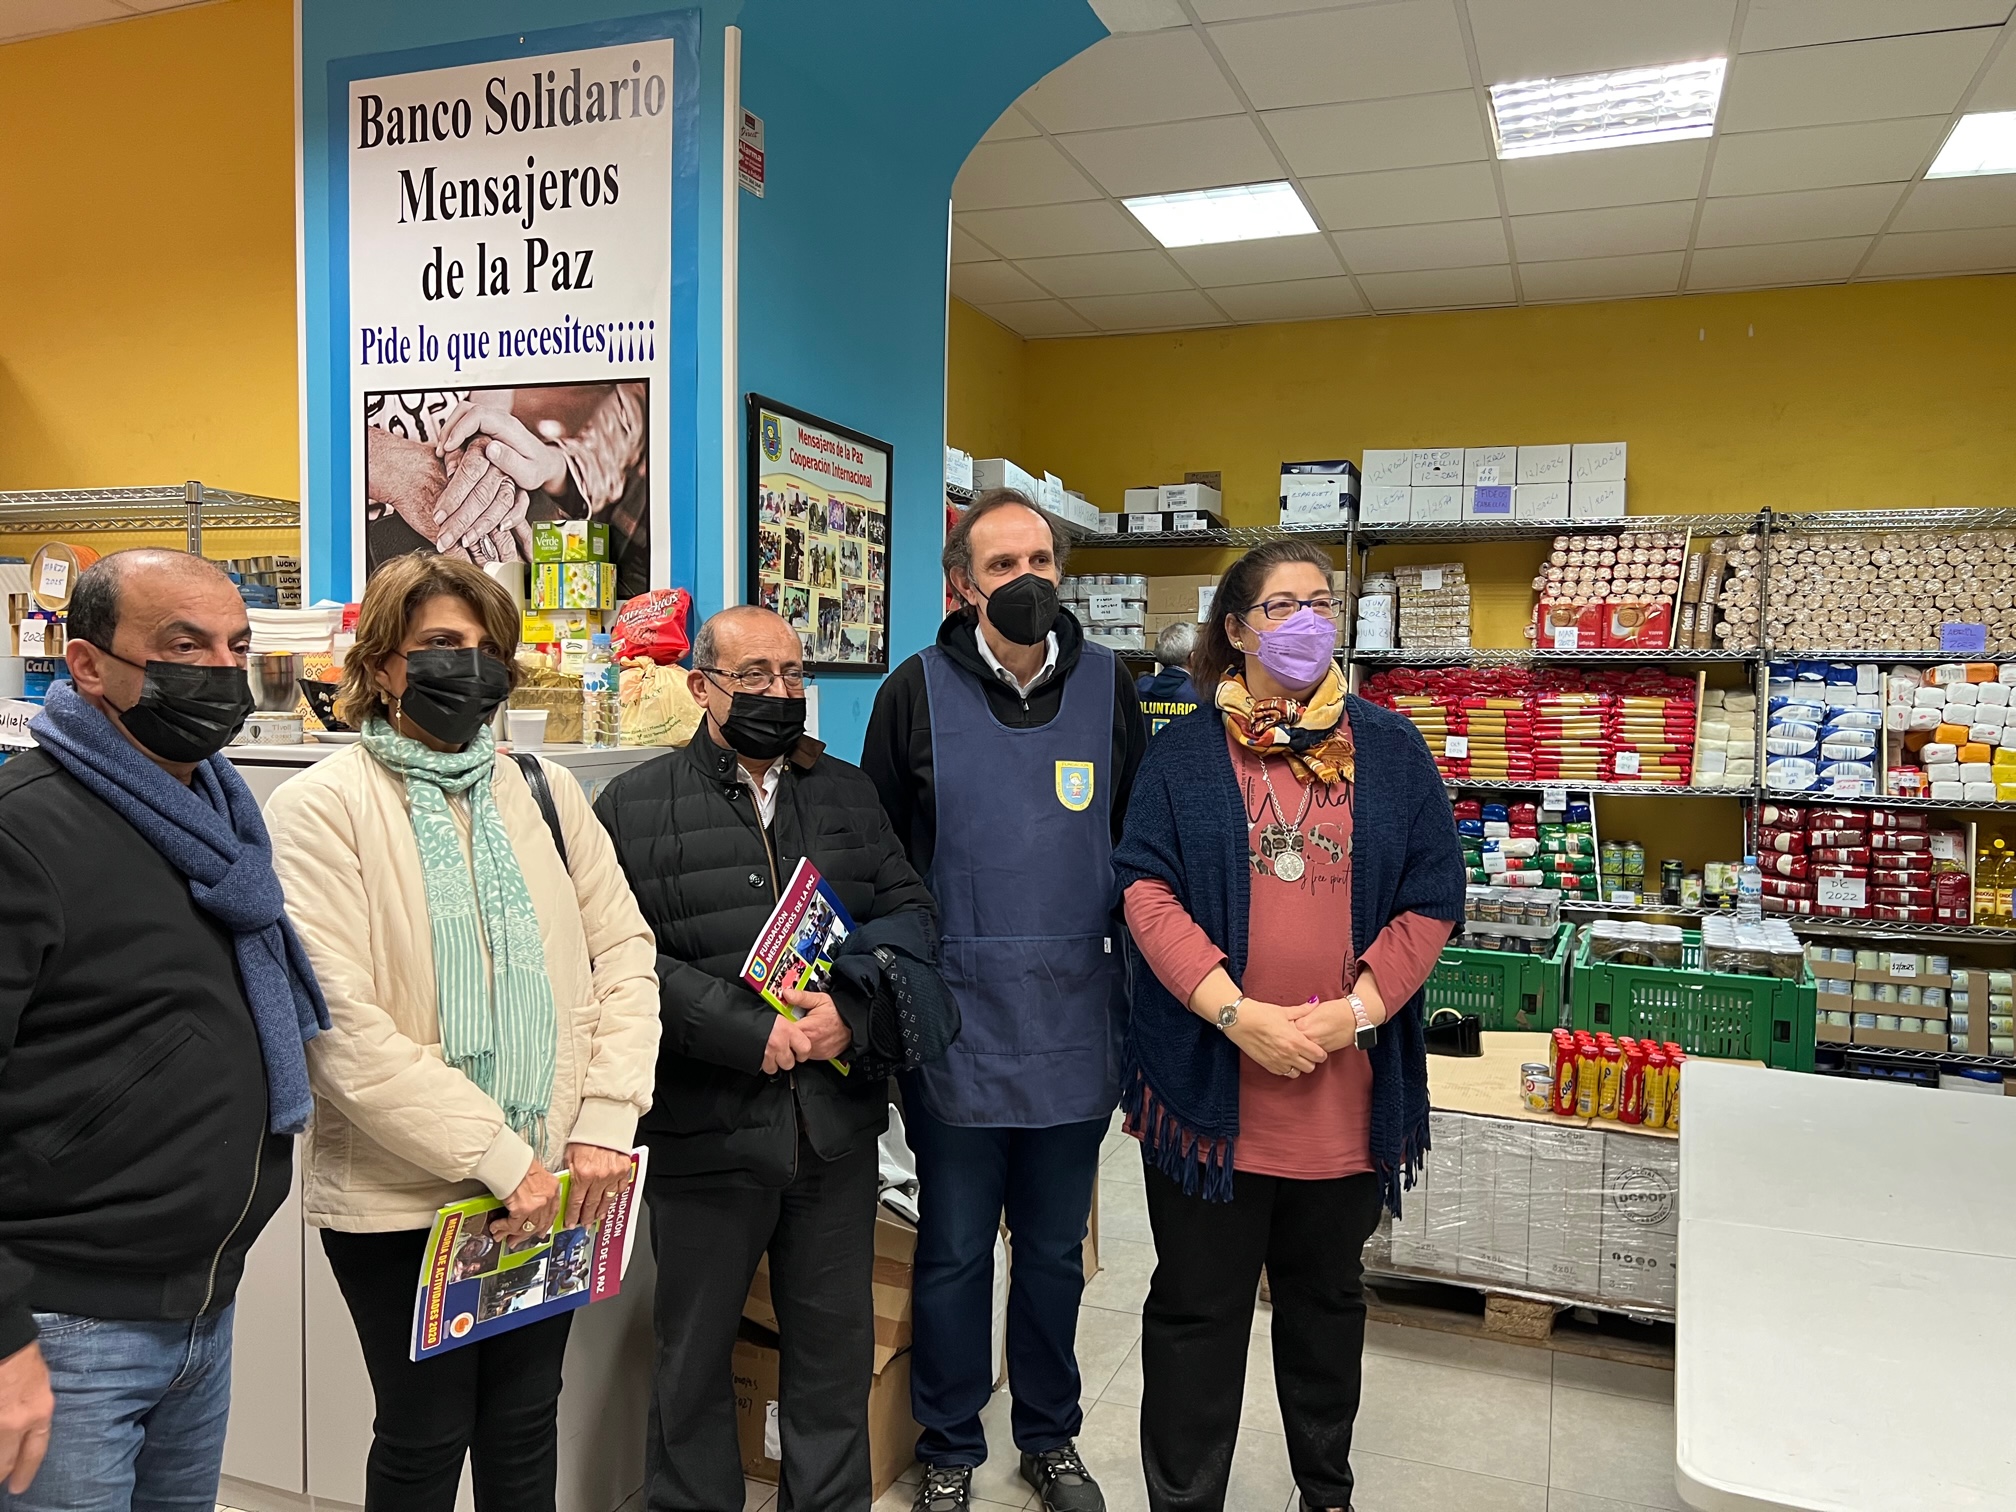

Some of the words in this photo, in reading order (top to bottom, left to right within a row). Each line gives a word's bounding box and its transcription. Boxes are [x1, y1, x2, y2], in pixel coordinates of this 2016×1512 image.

[357, 92, 472, 150] Banco
[484, 59, 667, 137] Solidario
[397, 156, 620, 230] Mensajeros
[422, 246, 465, 301] de
[476, 242, 510, 297] la
[523, 237, 594, 294] Paz
[361, 325, 411, 366] Pide
[418, 325, 439, 363] lo
[447, 328, 490, 372] que
[798, 427, 836, 454] Mensajeros
[836, 441, 844, 458] de
[844, 443, 851, 460] la
[851, 446, 864, 464] Paz
[789, 447, 831, 474] Cooperación
[831, 461, 873, 489] Internacional
[1481, 488, 1508, 498] FIDEOS
[536, 535, 560, 547] Verde
[276, 560, 297, 568] LUCKY
[279, 576, 301, 584] LUCKY
[281, 592, 301, 600] LUCKY
[1311, 866, 1327, 896] free
[1330, 863, 1352, 897] spirit
[1826, 891, 1858, 901] 2022
[760, 910, 789, 957] FUNDACIÓN
[765, 912, 797, 964] MENSAJEROS
[794, 900, 804, 913] DE
[800, 890, 809, 902] LA
[805, 874, 816, 891] PAZ
[440, 1217, 458, 1254] MEMORIA
[437, 1254, 447, 1267] DE
[598, 1262, 607, 1275] LA
[599, 1247, 609, 1261] DE
[430, 1267, 445, 1320] ACTIVIDADES
[596, 1275, 606, 1294] PAZ
[427, 1320, 438, 1344] 2020
